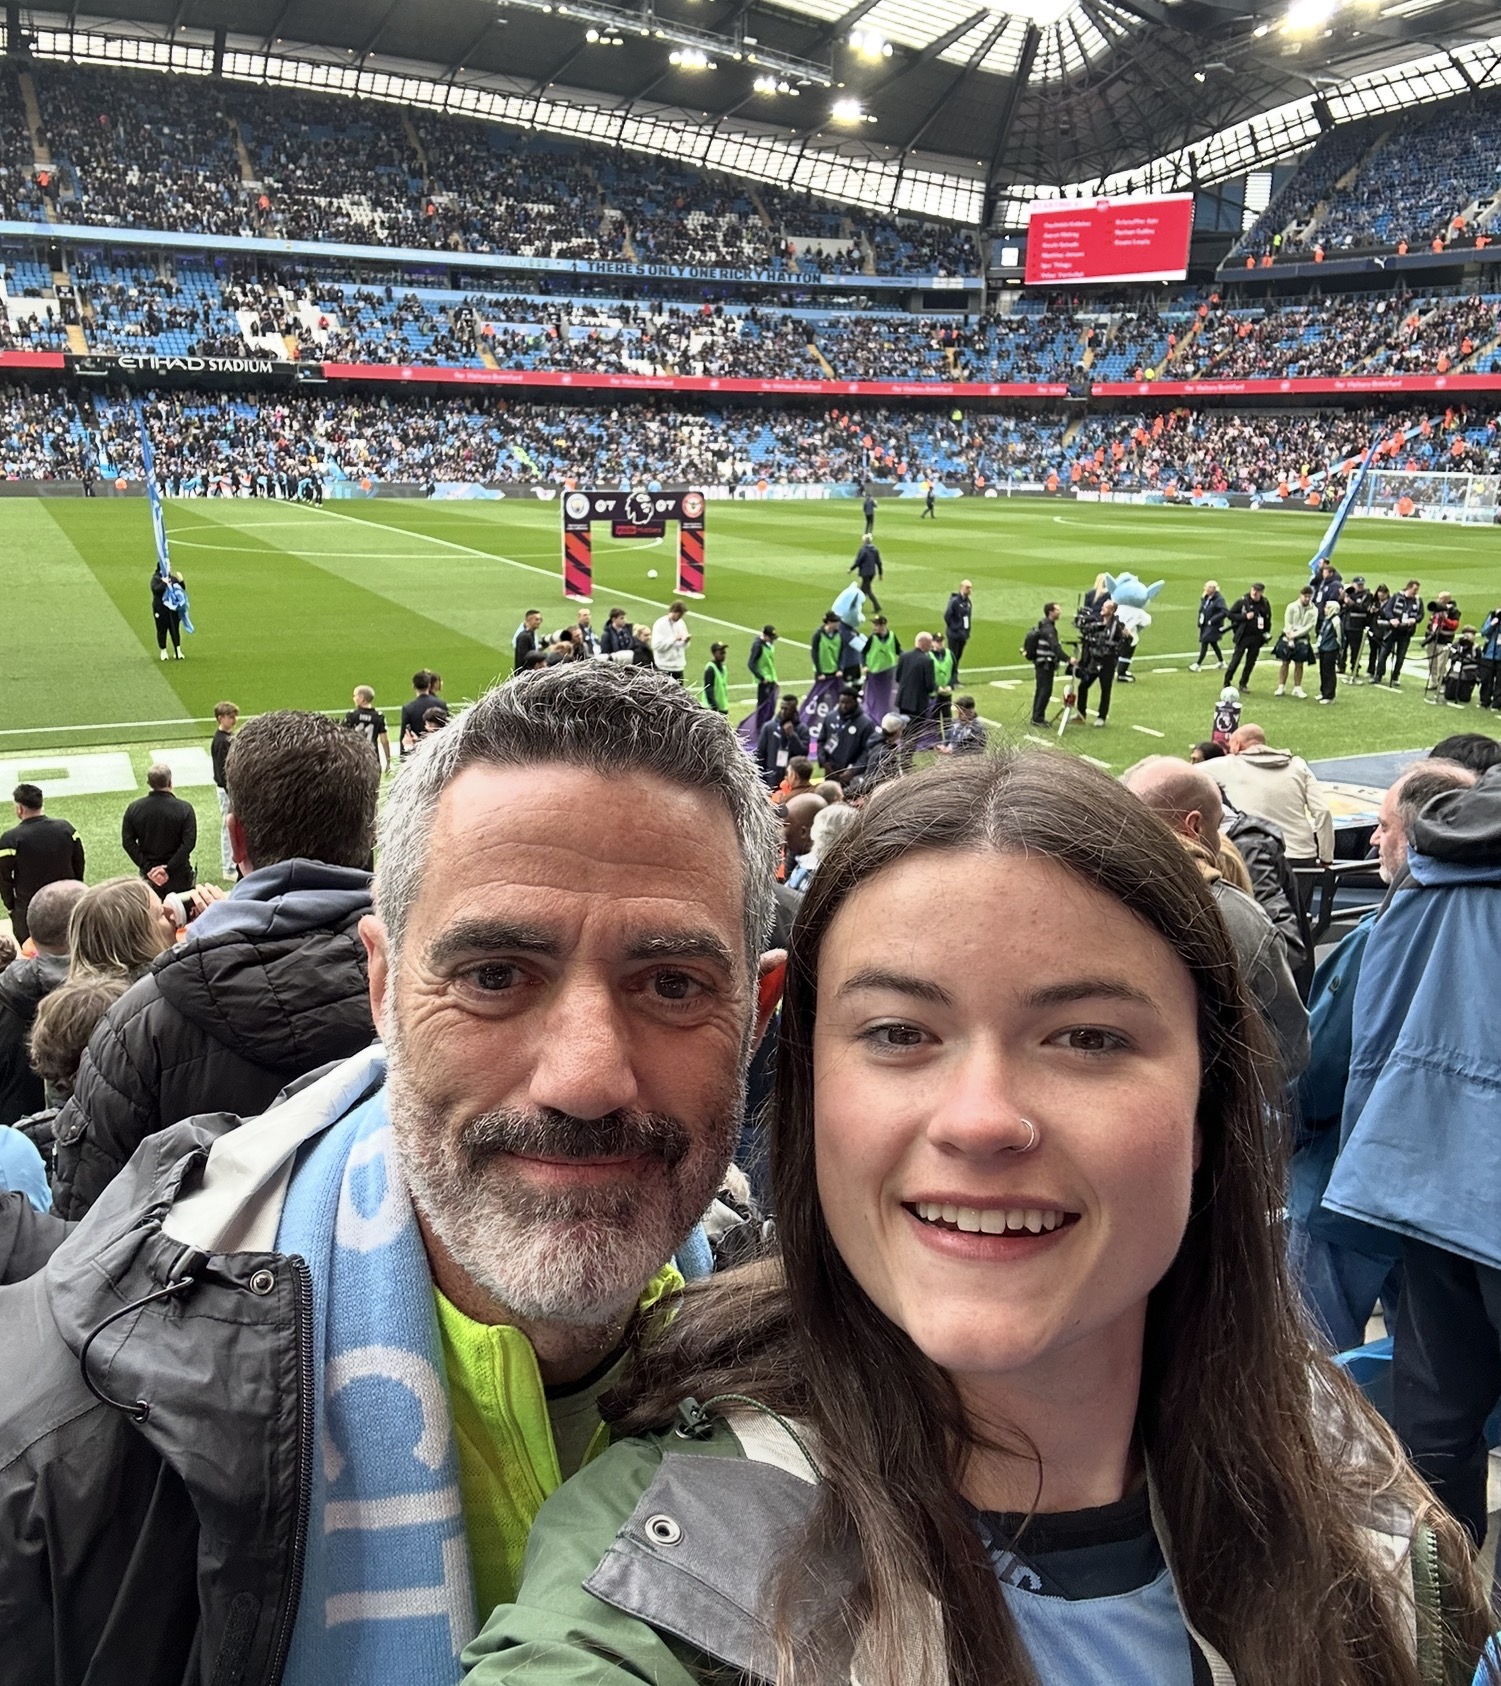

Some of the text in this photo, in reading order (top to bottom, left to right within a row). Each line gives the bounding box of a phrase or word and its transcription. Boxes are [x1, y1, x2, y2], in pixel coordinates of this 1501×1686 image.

[649, 265, 686, 277] ONLY
[690, 267, 717, 278] ONE
[720, 269, 766, 280] RICKY
[767, 271, 821, 284] HATTON
[118, 355, 273, 374] ETIHAD STADIUM
